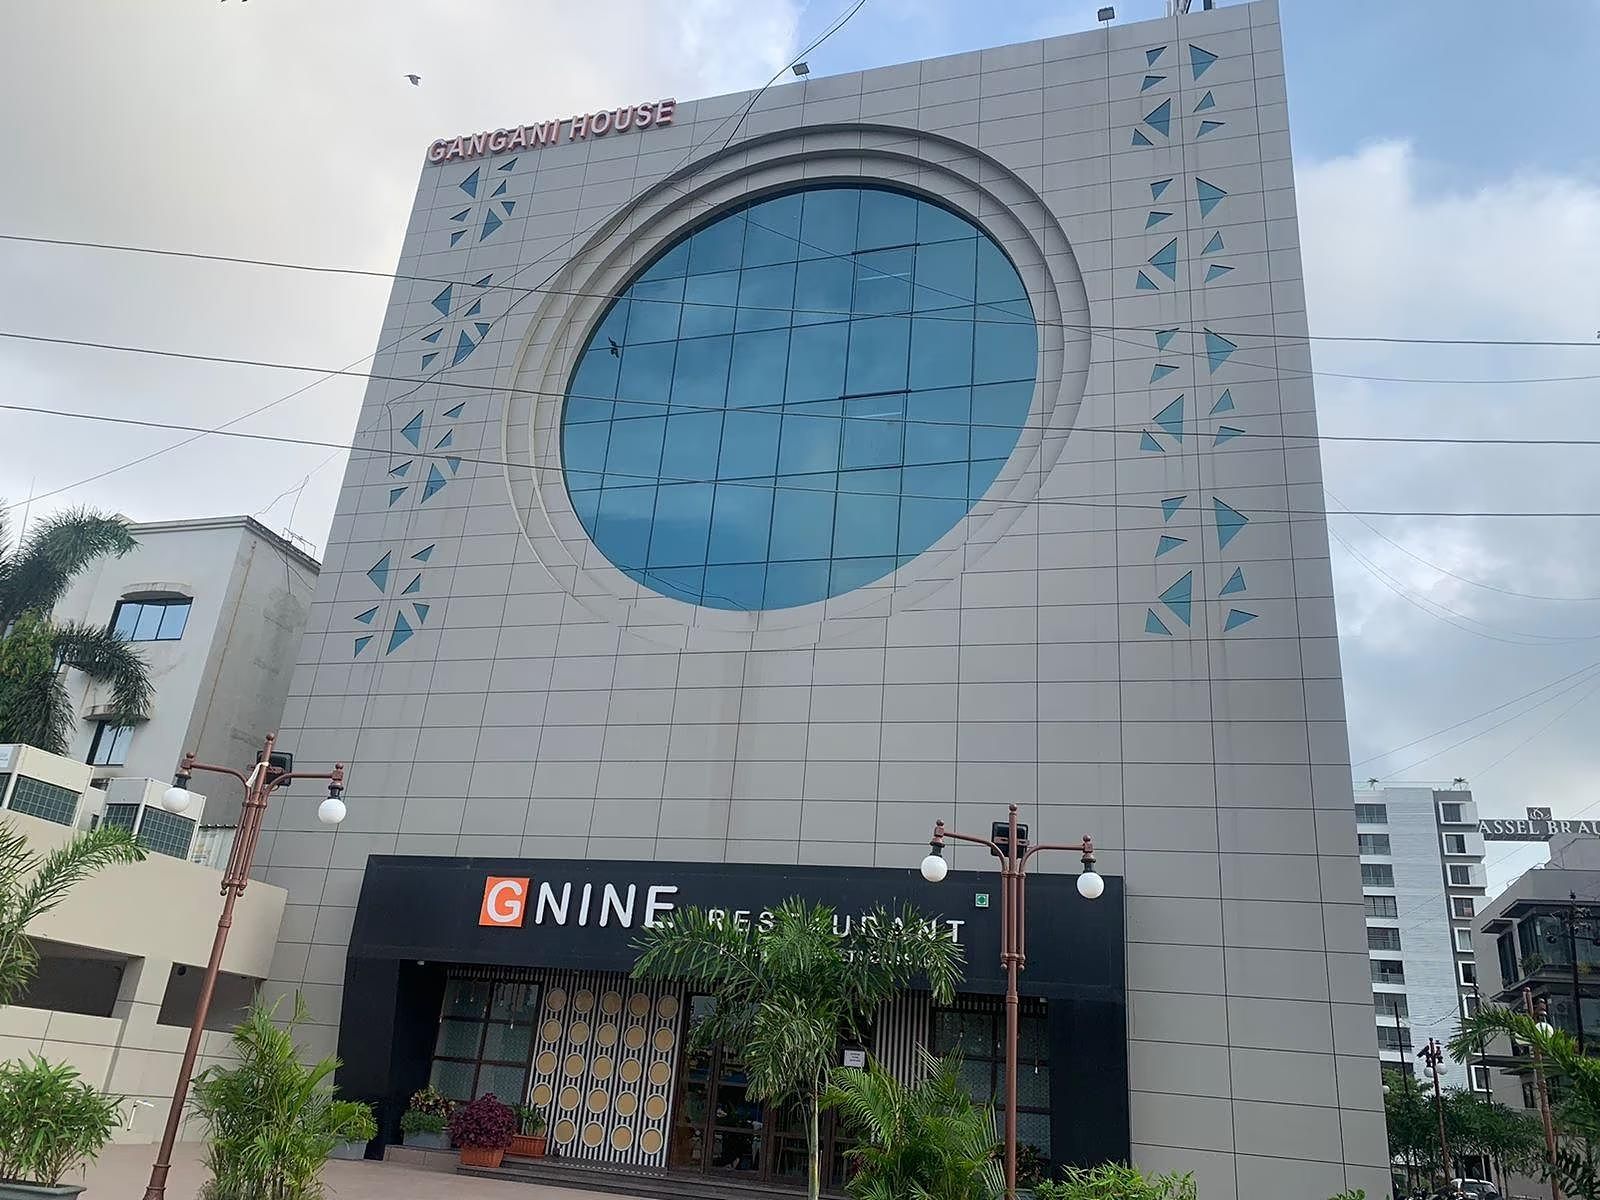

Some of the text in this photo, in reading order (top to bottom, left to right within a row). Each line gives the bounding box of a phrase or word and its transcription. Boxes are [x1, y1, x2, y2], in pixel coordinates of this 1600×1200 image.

[428, 97, 676, 164] GANGANI HOUSE
[708, 909, 965, 943] RESURANT
